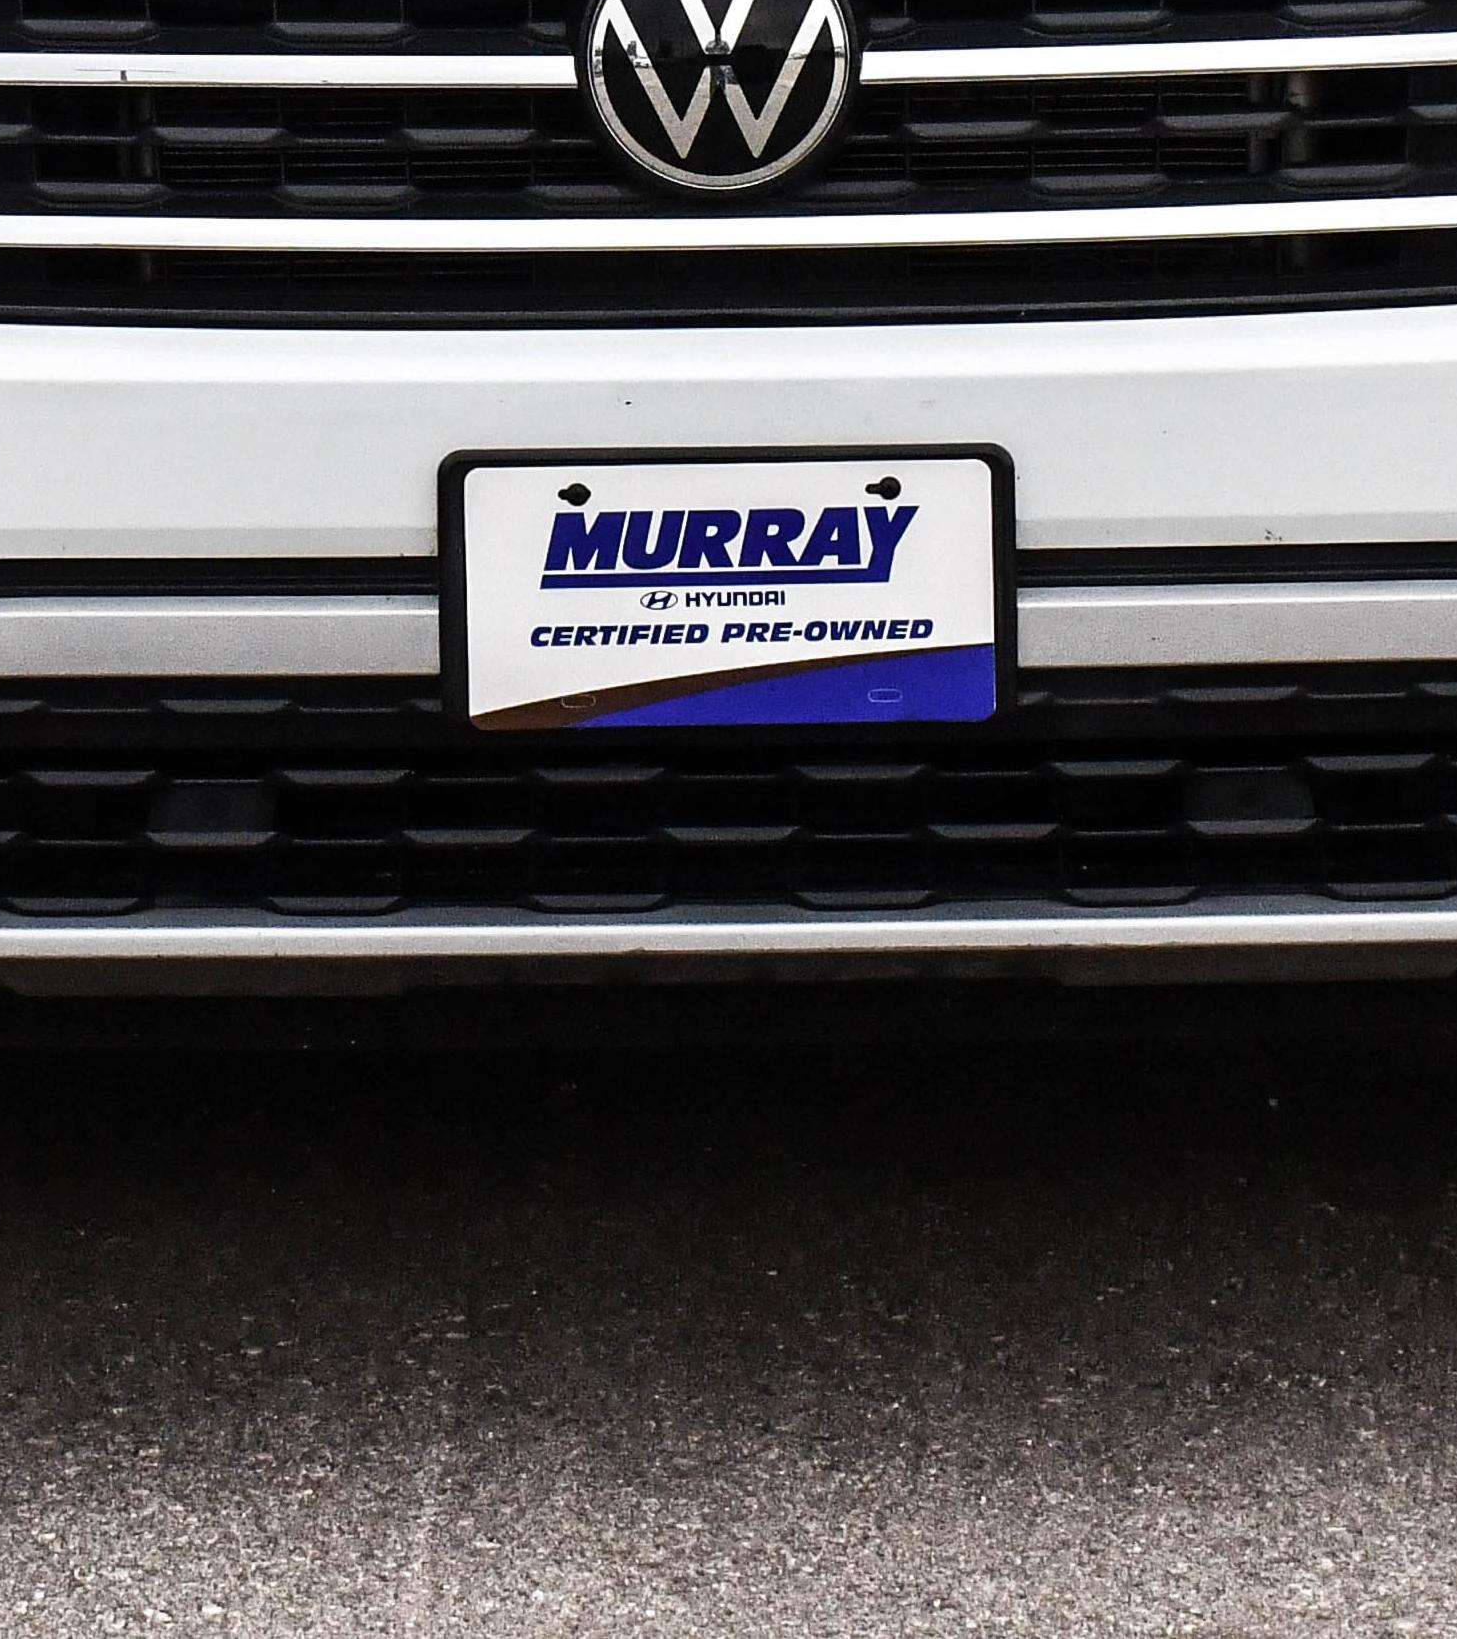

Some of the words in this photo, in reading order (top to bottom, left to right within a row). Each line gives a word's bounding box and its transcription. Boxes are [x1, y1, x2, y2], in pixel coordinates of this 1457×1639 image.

[542, 505, 921, 573] MURRAY
[685, 590, 786, 608] HYUNDAI
[530, 623, 710, 648] CERTIFIED
[720, 618, 934, 644] PRE-OWNED
